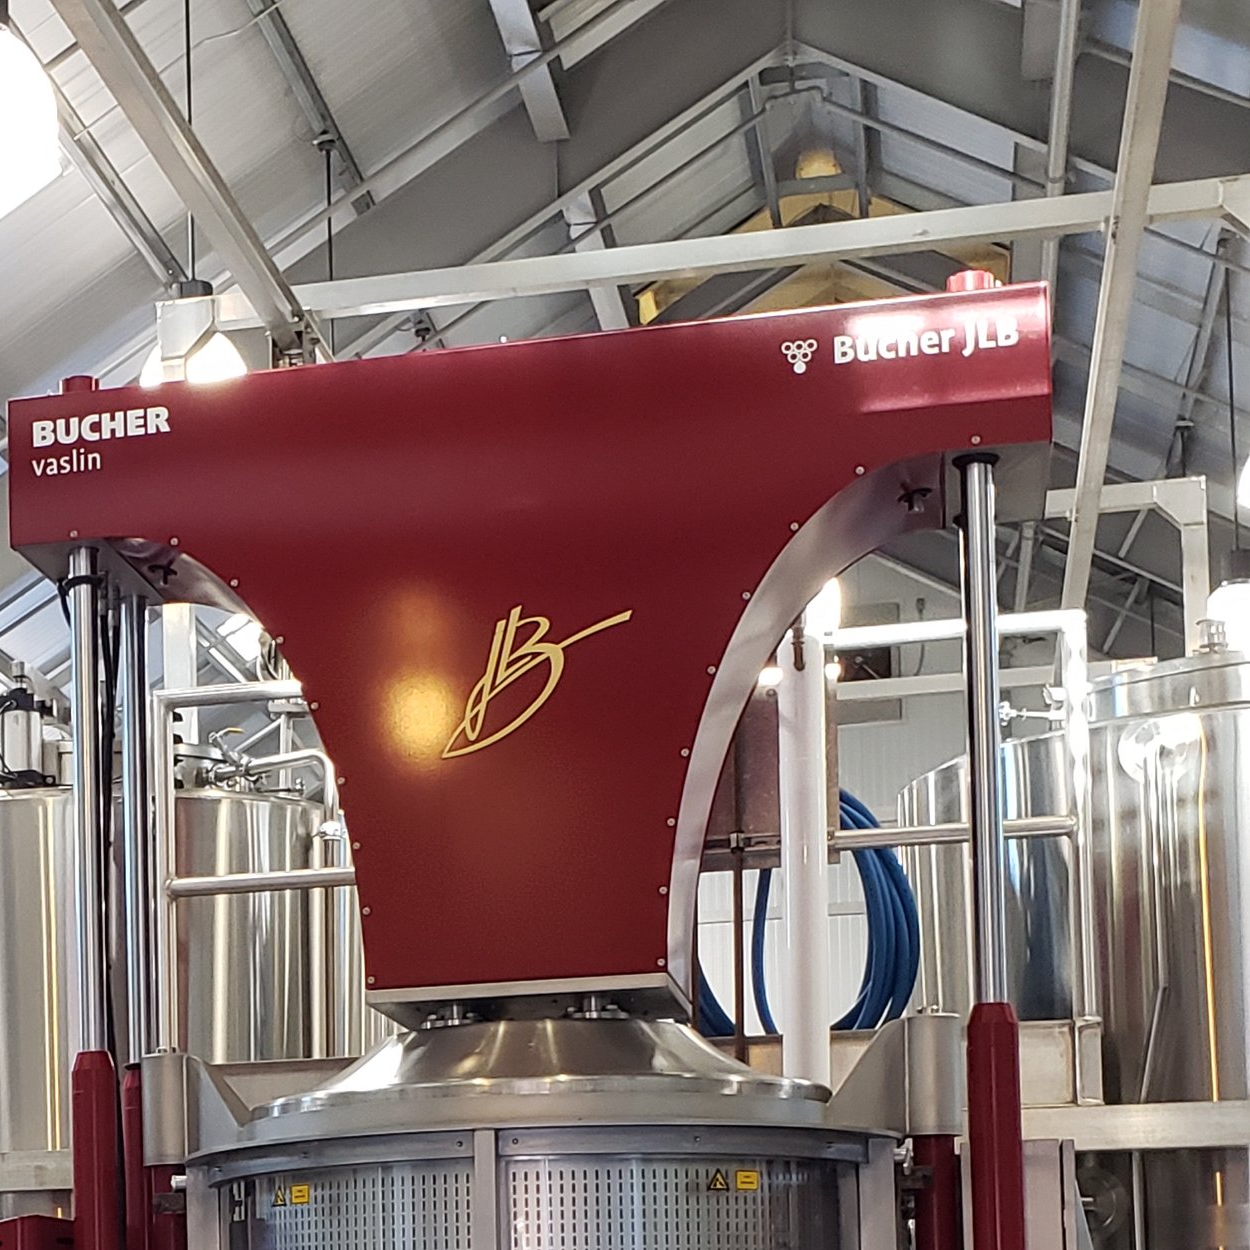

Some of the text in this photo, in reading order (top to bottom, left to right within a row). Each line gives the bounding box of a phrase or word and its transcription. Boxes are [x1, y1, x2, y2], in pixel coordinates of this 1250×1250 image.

[962, 314, 1020, 358] JLB
[32, 406, 171, 448] BUCHER
[32, 448, 101, 477] vaslin
